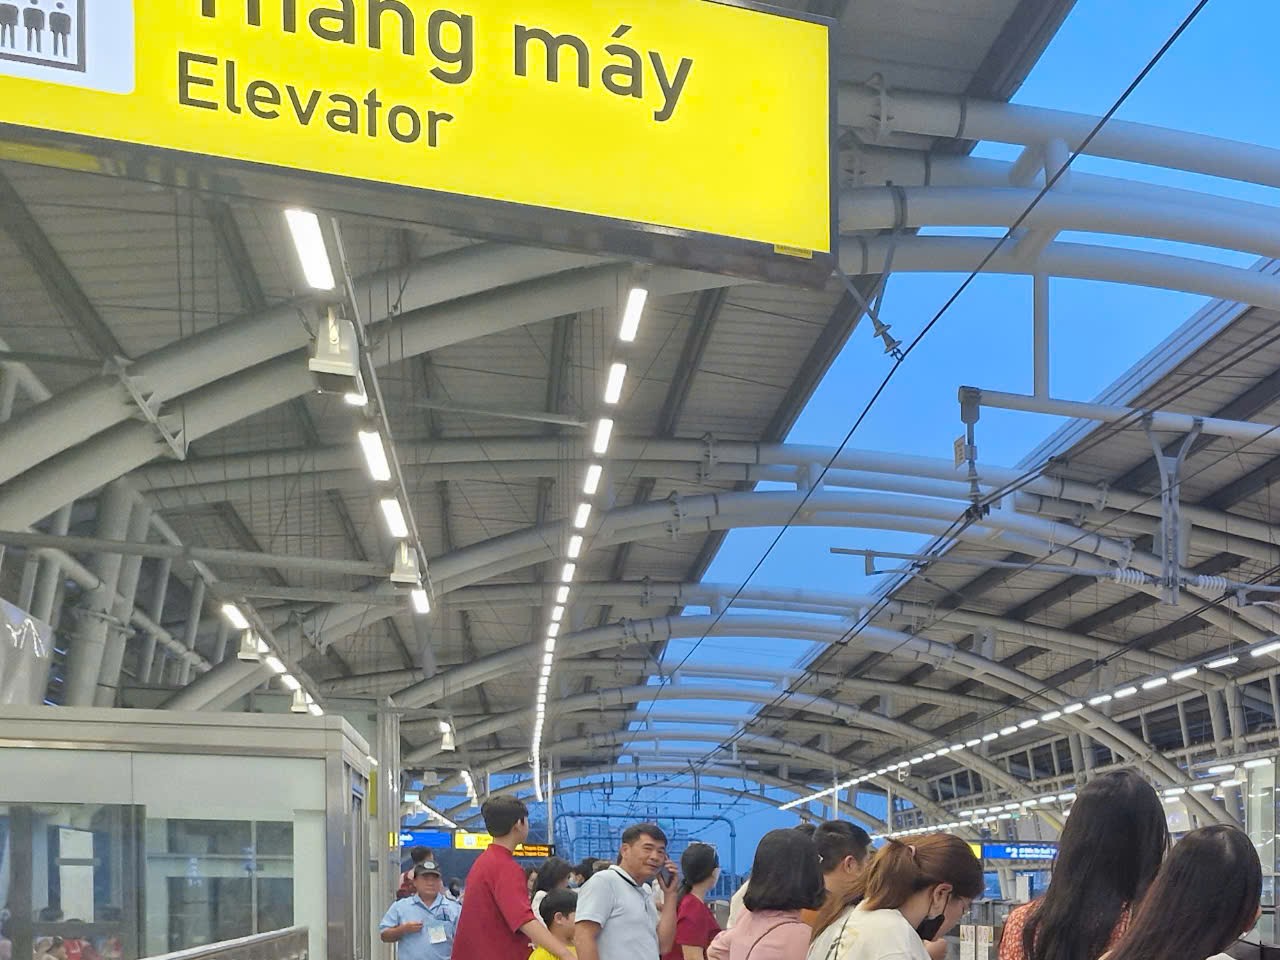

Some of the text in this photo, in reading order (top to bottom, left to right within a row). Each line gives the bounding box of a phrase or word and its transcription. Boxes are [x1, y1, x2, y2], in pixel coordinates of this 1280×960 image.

[178, 50, 454, 147] Elevator
[201, 0, 693, 122] ang máy
